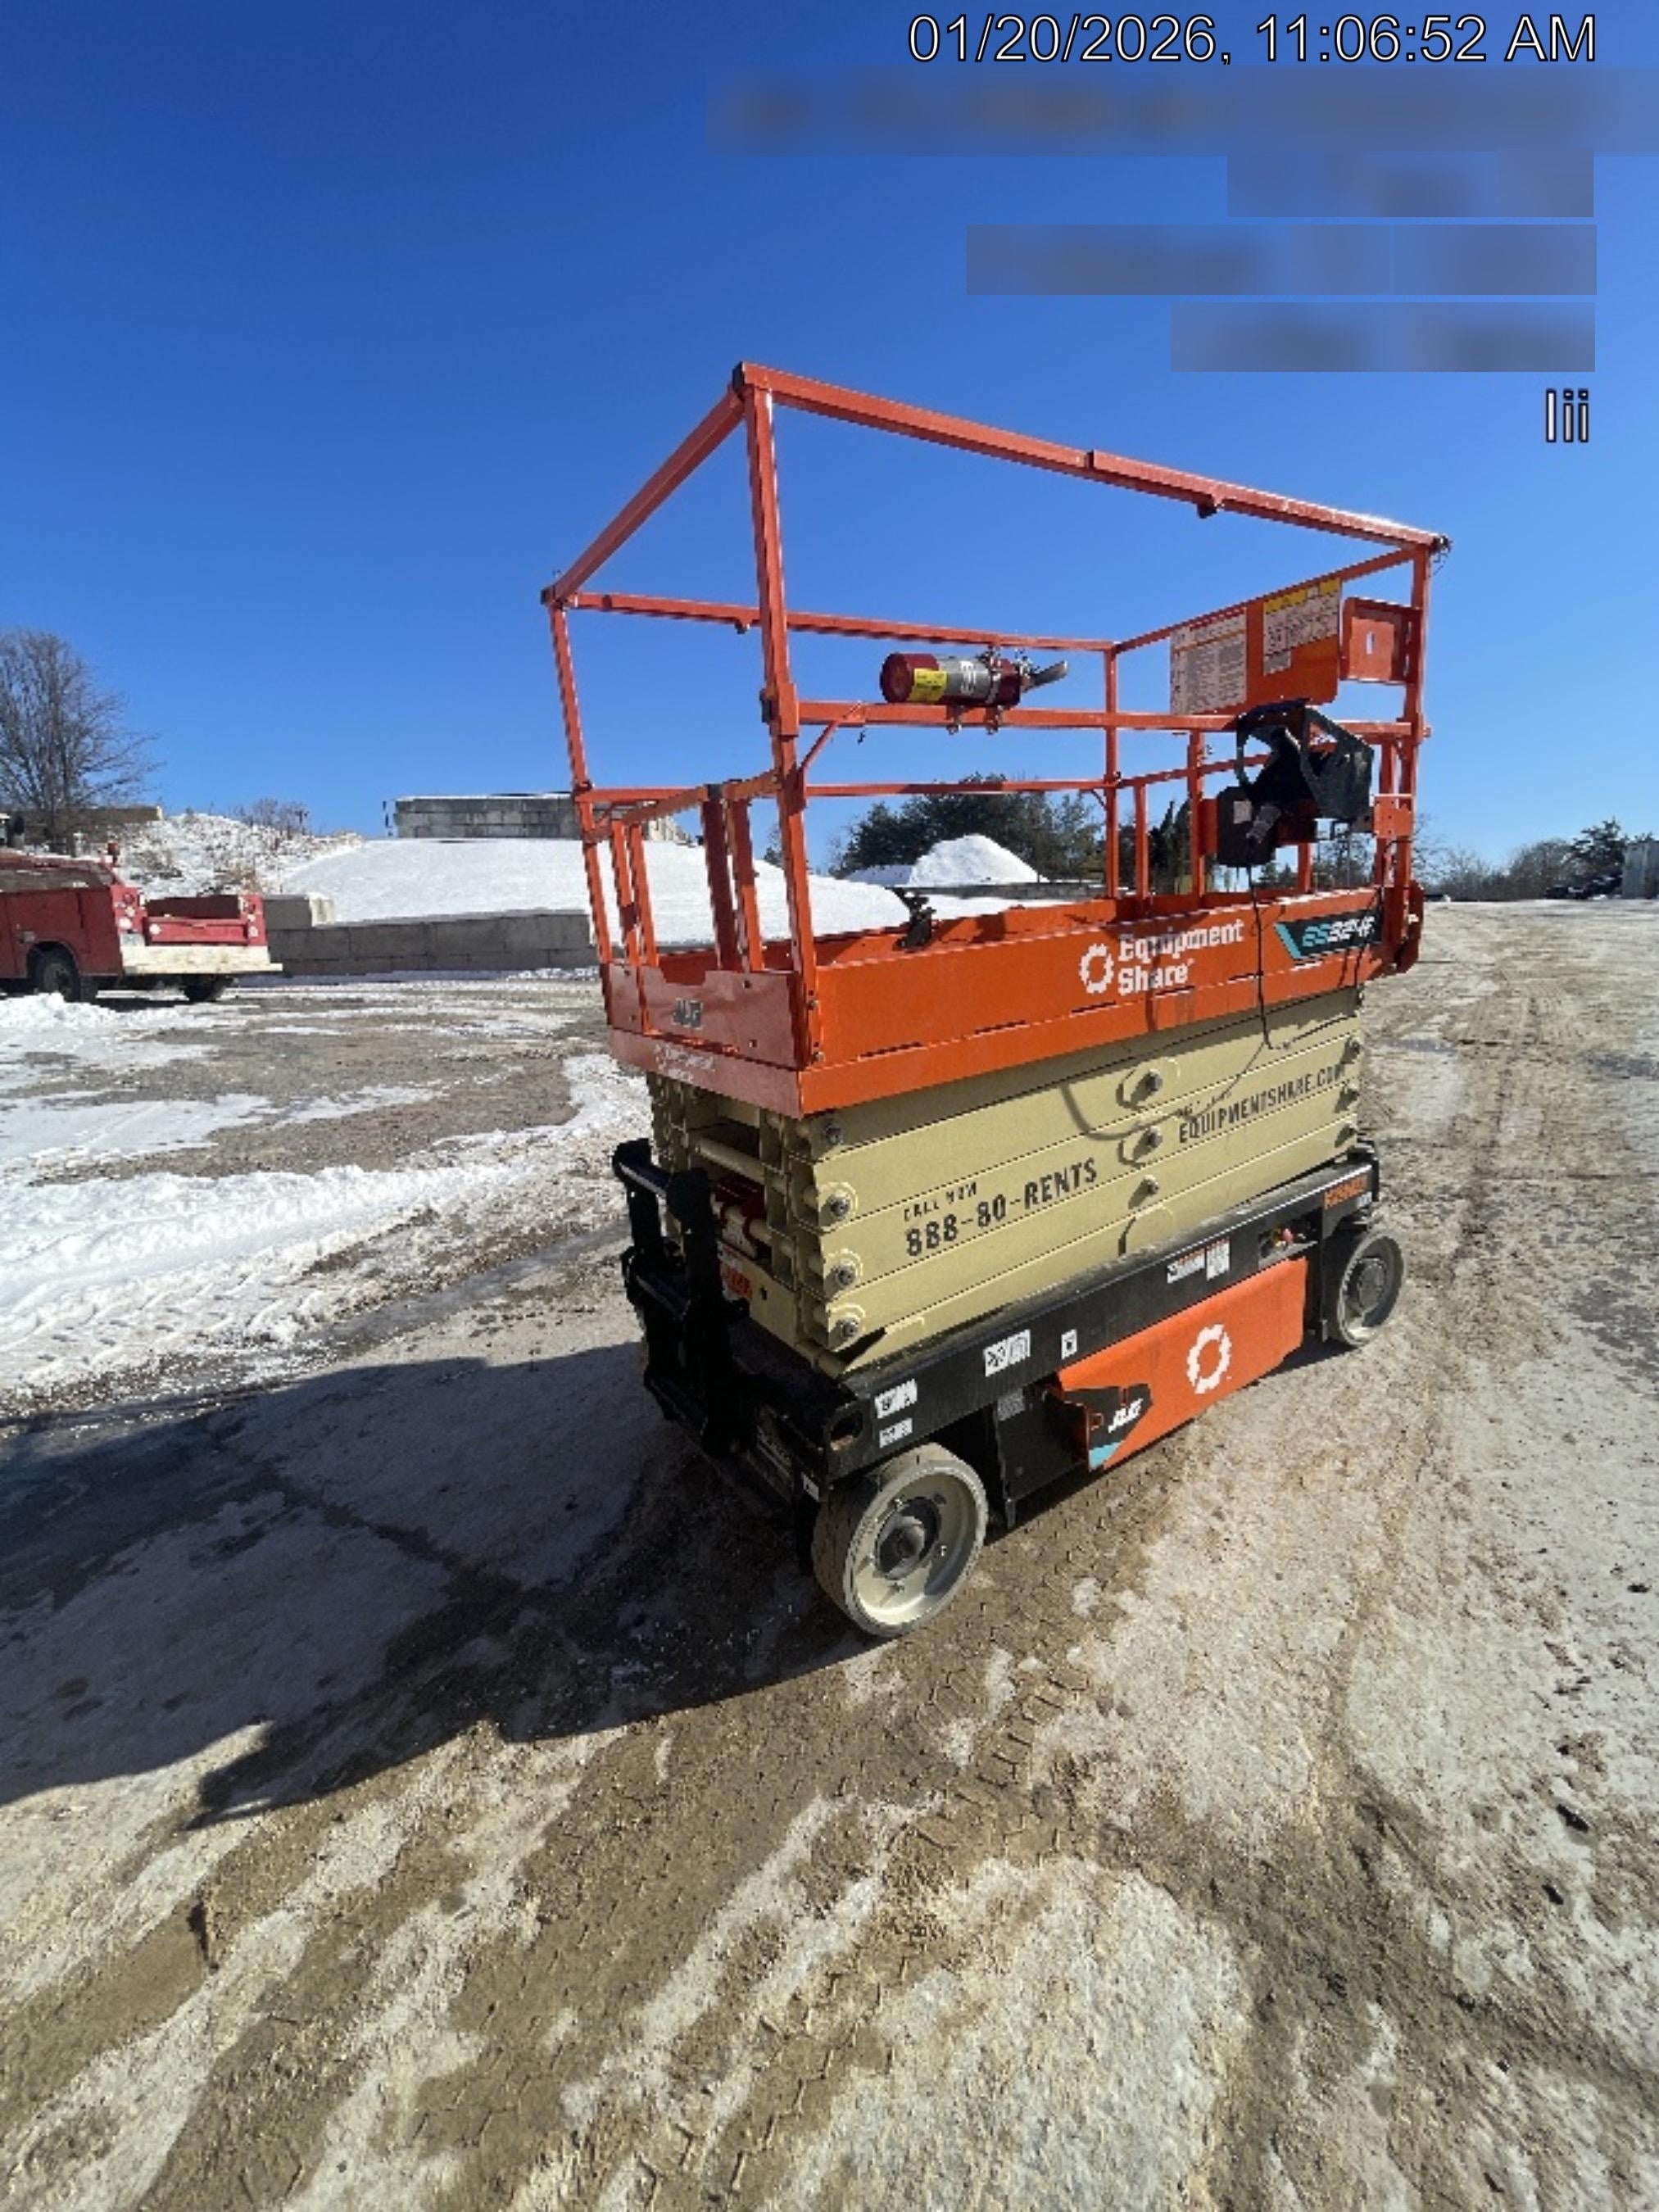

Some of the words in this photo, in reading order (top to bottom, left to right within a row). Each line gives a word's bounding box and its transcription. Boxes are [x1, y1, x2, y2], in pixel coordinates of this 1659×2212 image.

[1117, 918, 1244, 963] Equipment
[1117, 960, 1189, 996] Share
[905, 1157, 1098, 1257] 888-80-RENTS
